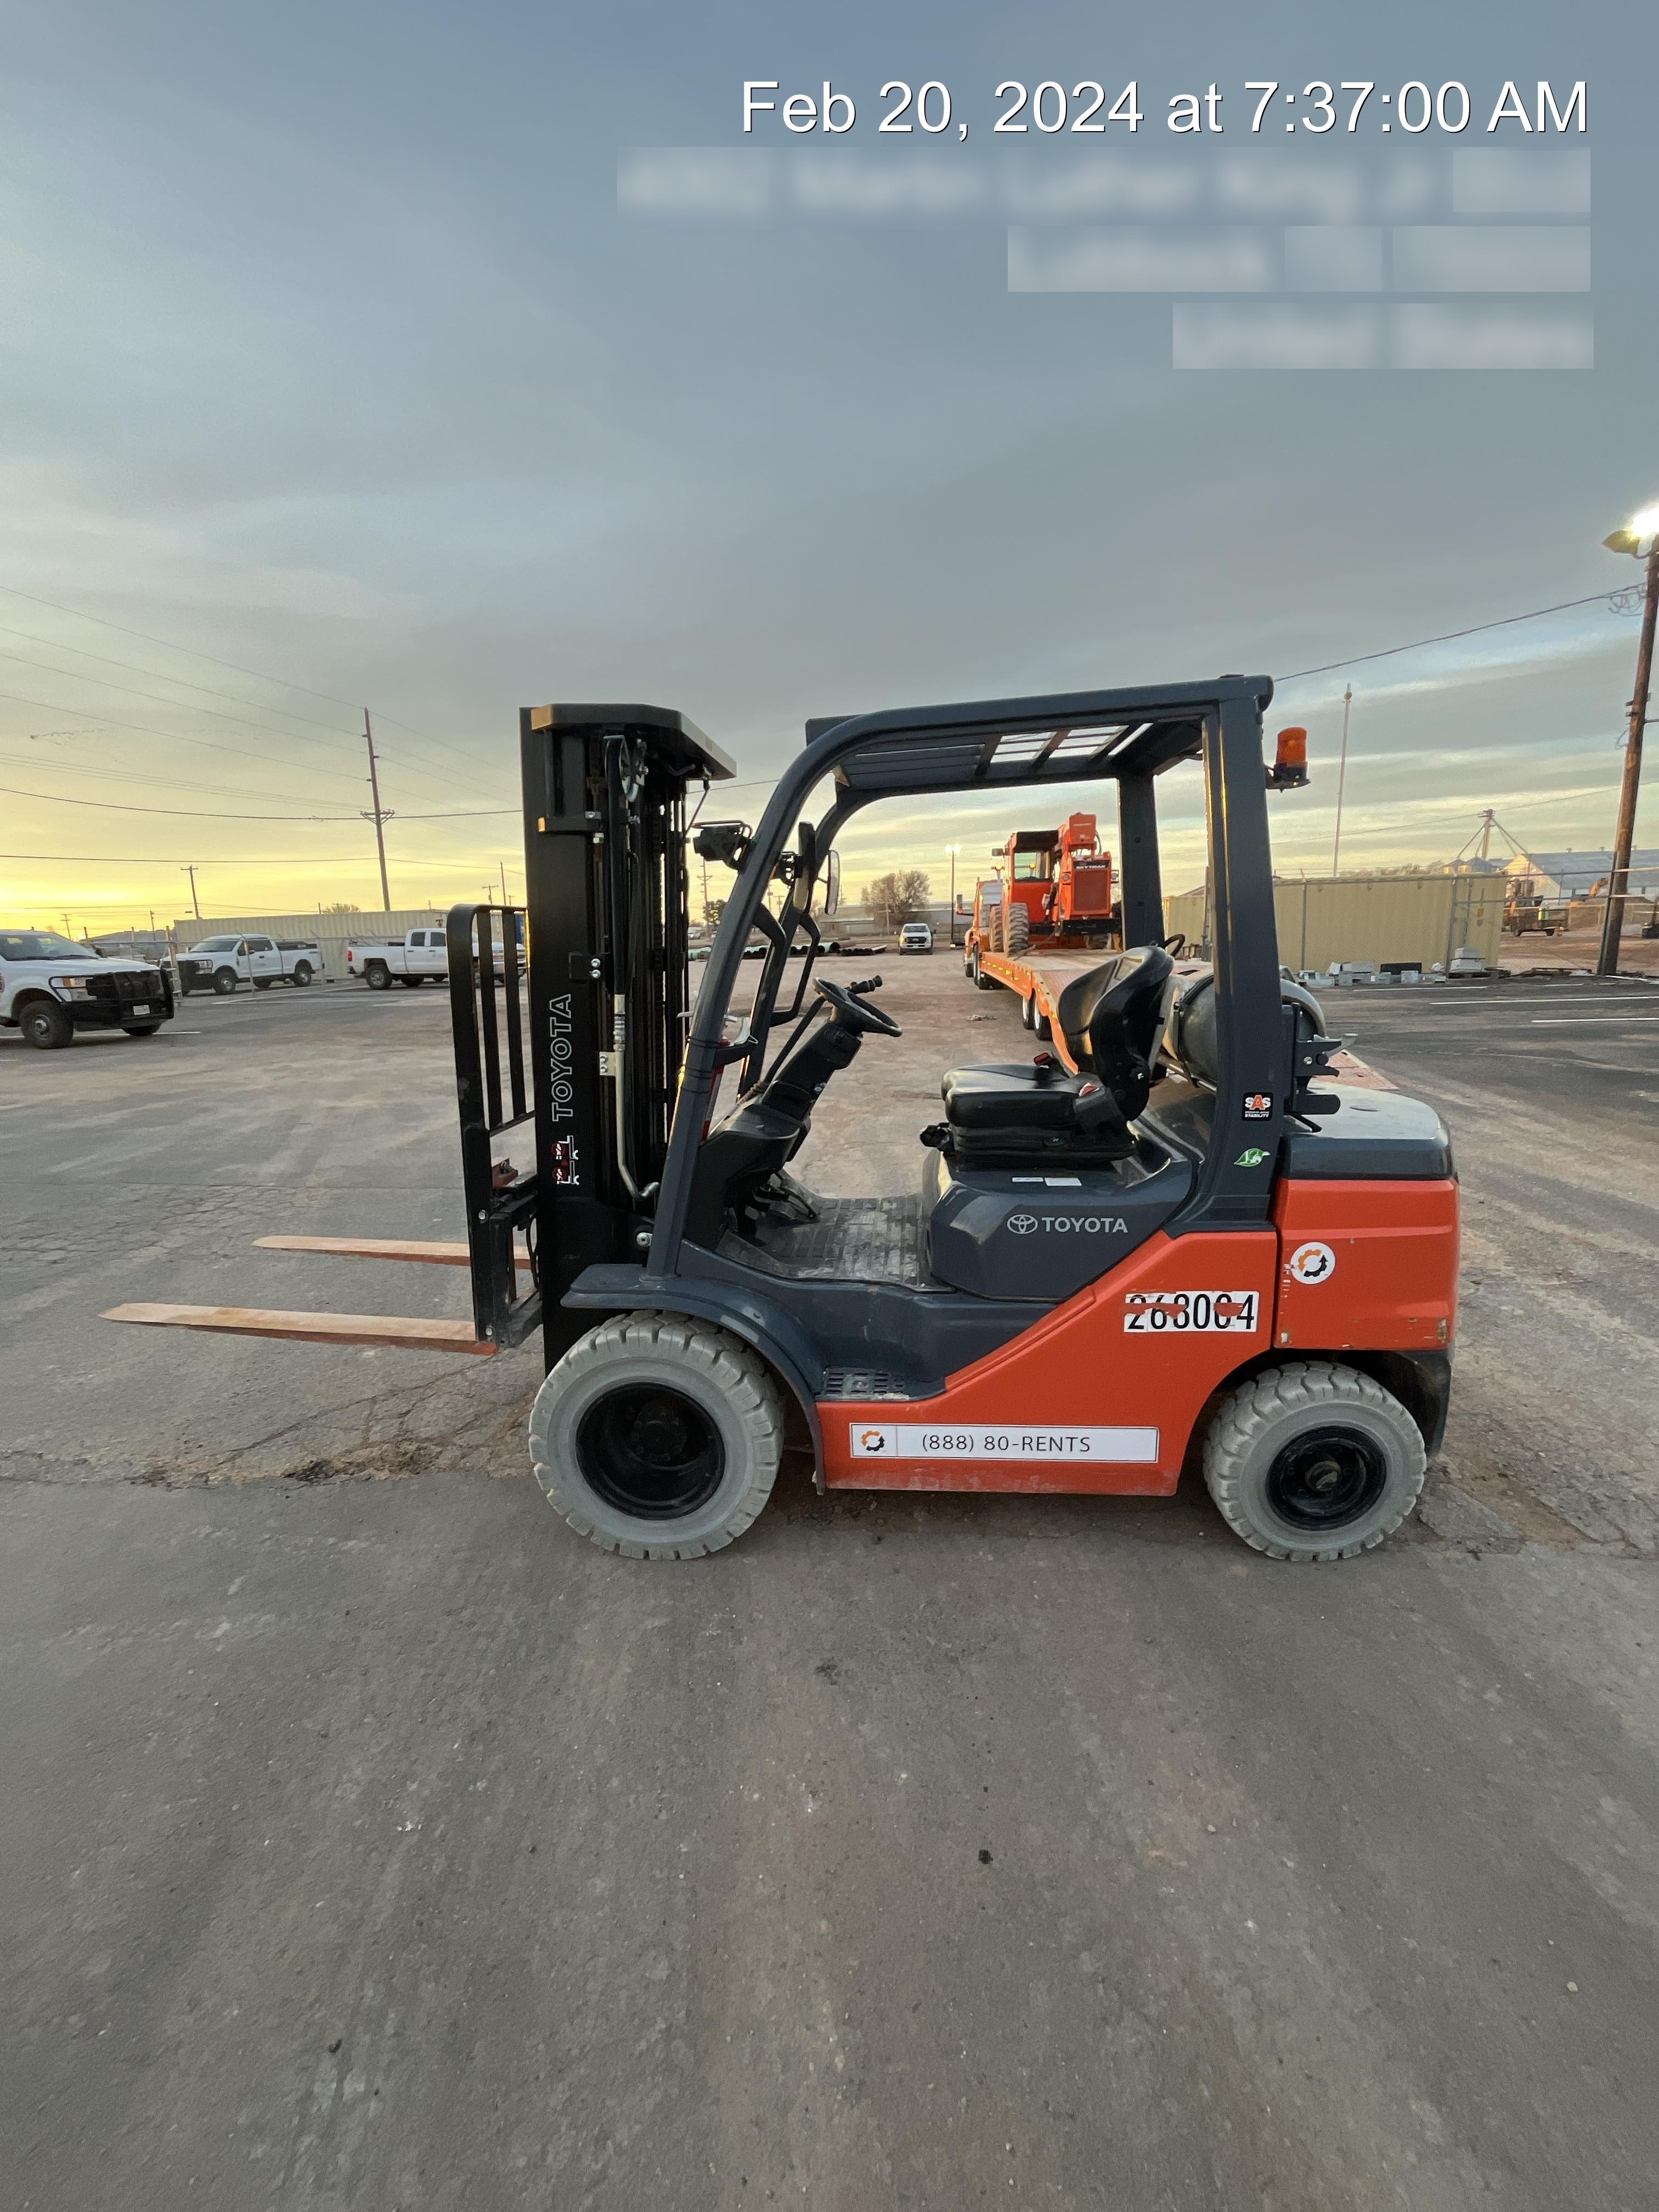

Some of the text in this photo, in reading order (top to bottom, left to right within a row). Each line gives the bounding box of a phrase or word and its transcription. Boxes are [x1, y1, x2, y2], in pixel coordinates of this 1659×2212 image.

[549, 994, 573, 1121] TOYOTA
[1245, 1094, 1271, 1110] SAS
[1041, 1217, 1128, 1233] TOYOTA
[923, 1434, 1090, 1452] (888) 80-RENTS
